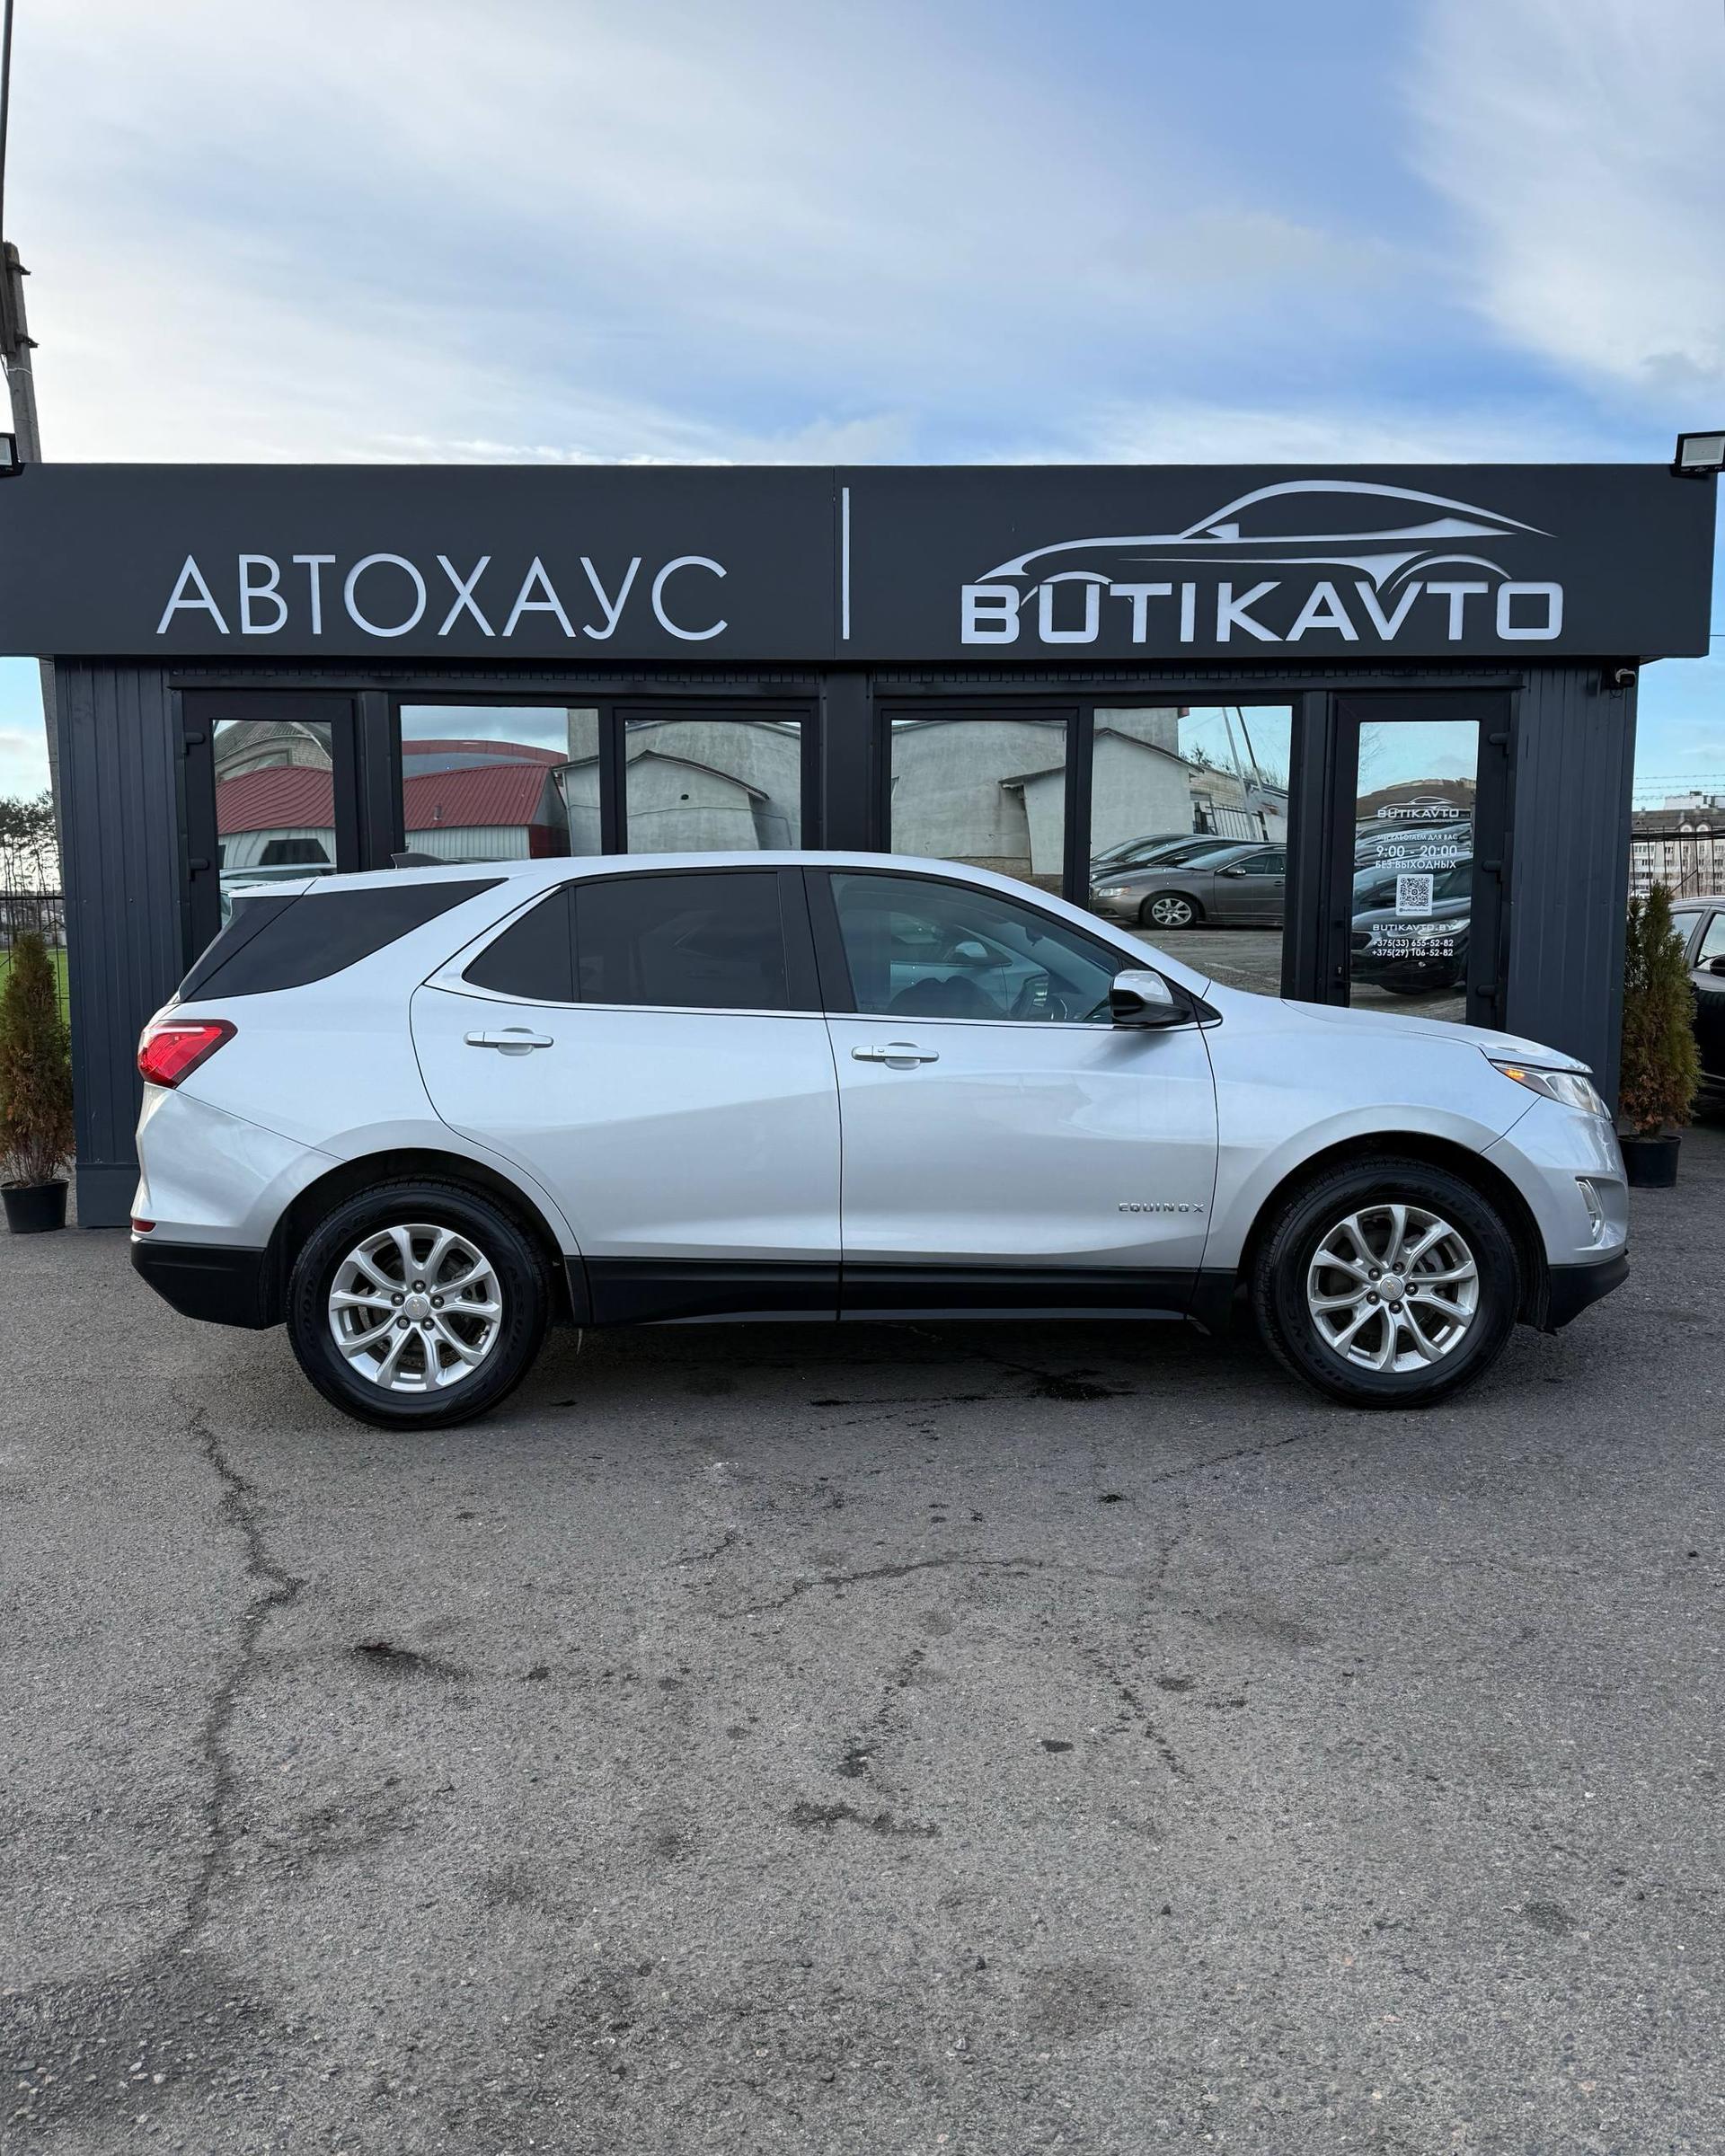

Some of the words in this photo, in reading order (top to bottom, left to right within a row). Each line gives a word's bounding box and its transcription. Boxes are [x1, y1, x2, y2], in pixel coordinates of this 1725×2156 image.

[155, 552, 730, 641] АВТОХАУС
[960, 579, 1565, 645] BUTIKAVTO
[1377, 808, 1460, 818] BUTIKAVTO
[1376, 845, 1405, 857] 9:00
[1420, 845, 1457, 857] 20:00
[1376, 860, 1393, 869] БЕЗ
[1394, 860, 1456, 870] ВЫХОДНЫХ
[1373, 939, 1410, 948] +375(33)
[1411, 939, 1454, 947] 655-52-82
[1372, 949, 1409, 958] +375(29)
[1411, 949, 1454, 957] 106-52-82
[1119, 1203, 1205, 1213] EQUINOX
